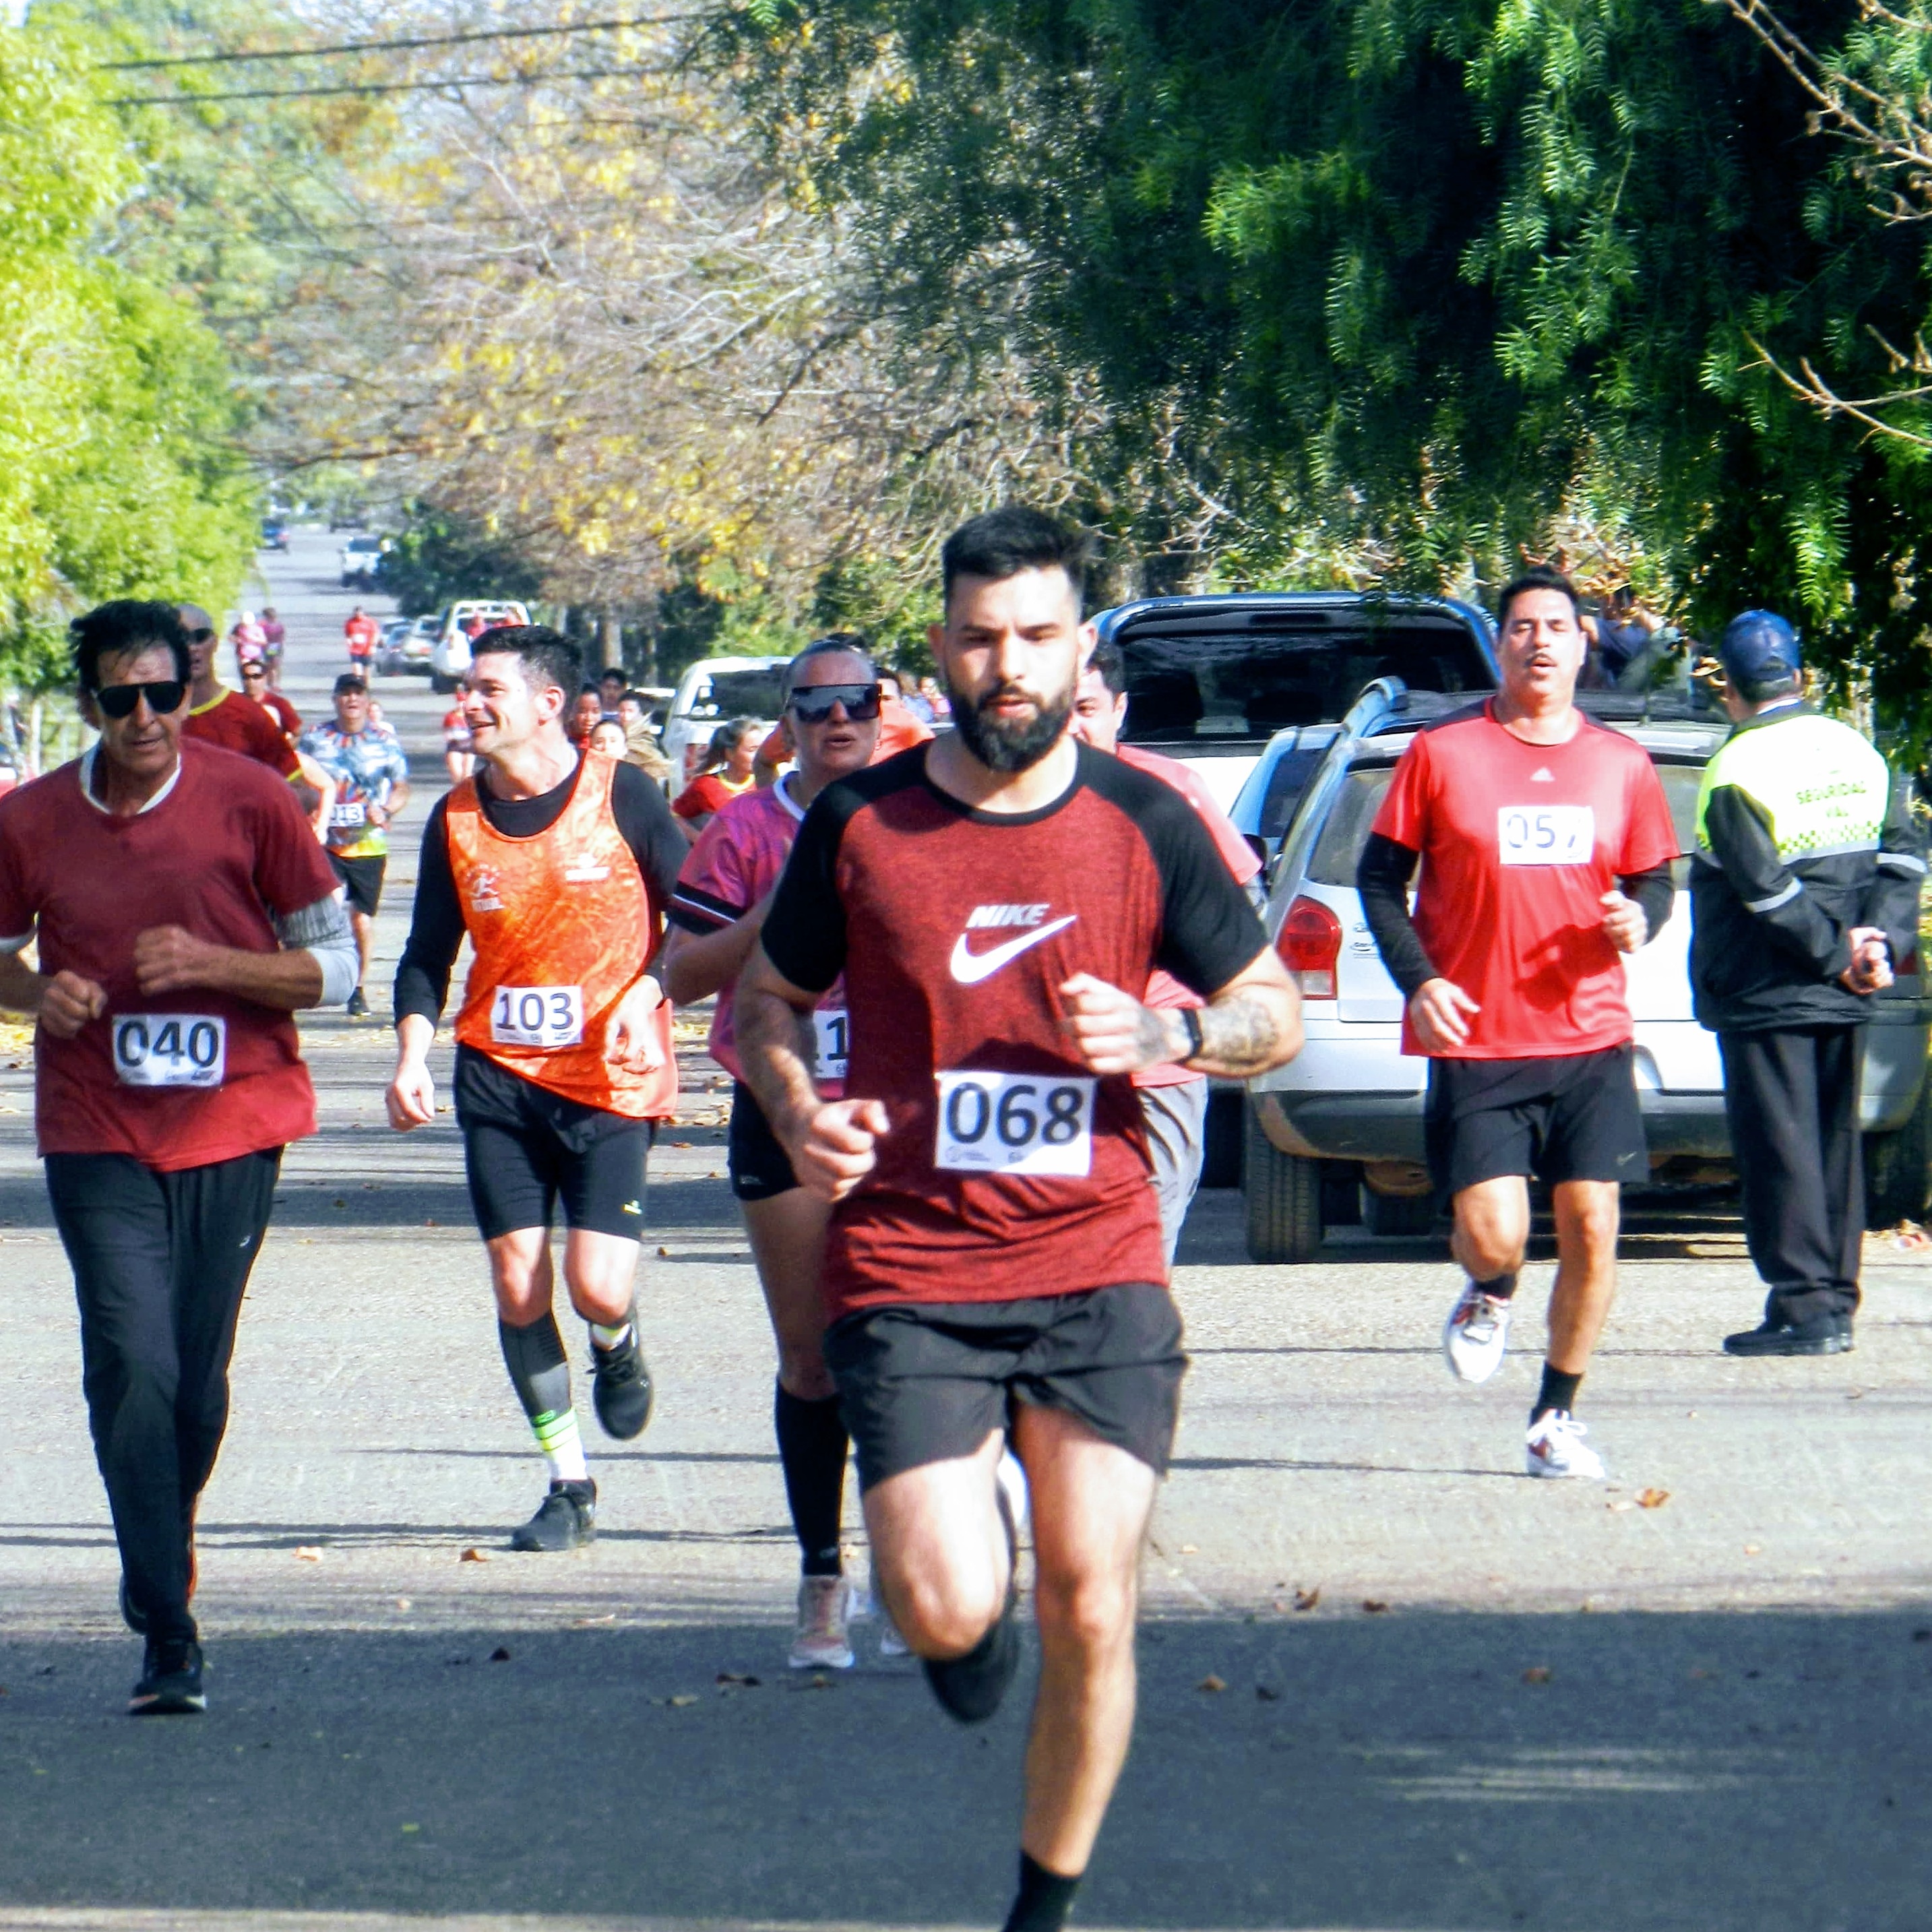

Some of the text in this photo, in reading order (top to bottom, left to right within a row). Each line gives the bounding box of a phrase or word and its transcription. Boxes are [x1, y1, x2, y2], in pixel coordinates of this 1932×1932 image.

[966, 904, 1051, 928] NIKE
[496, 993, 573, 1031] 103
[117, 1022, 218, 1067] 040
[947, 1082, 1082, 1146] 068
